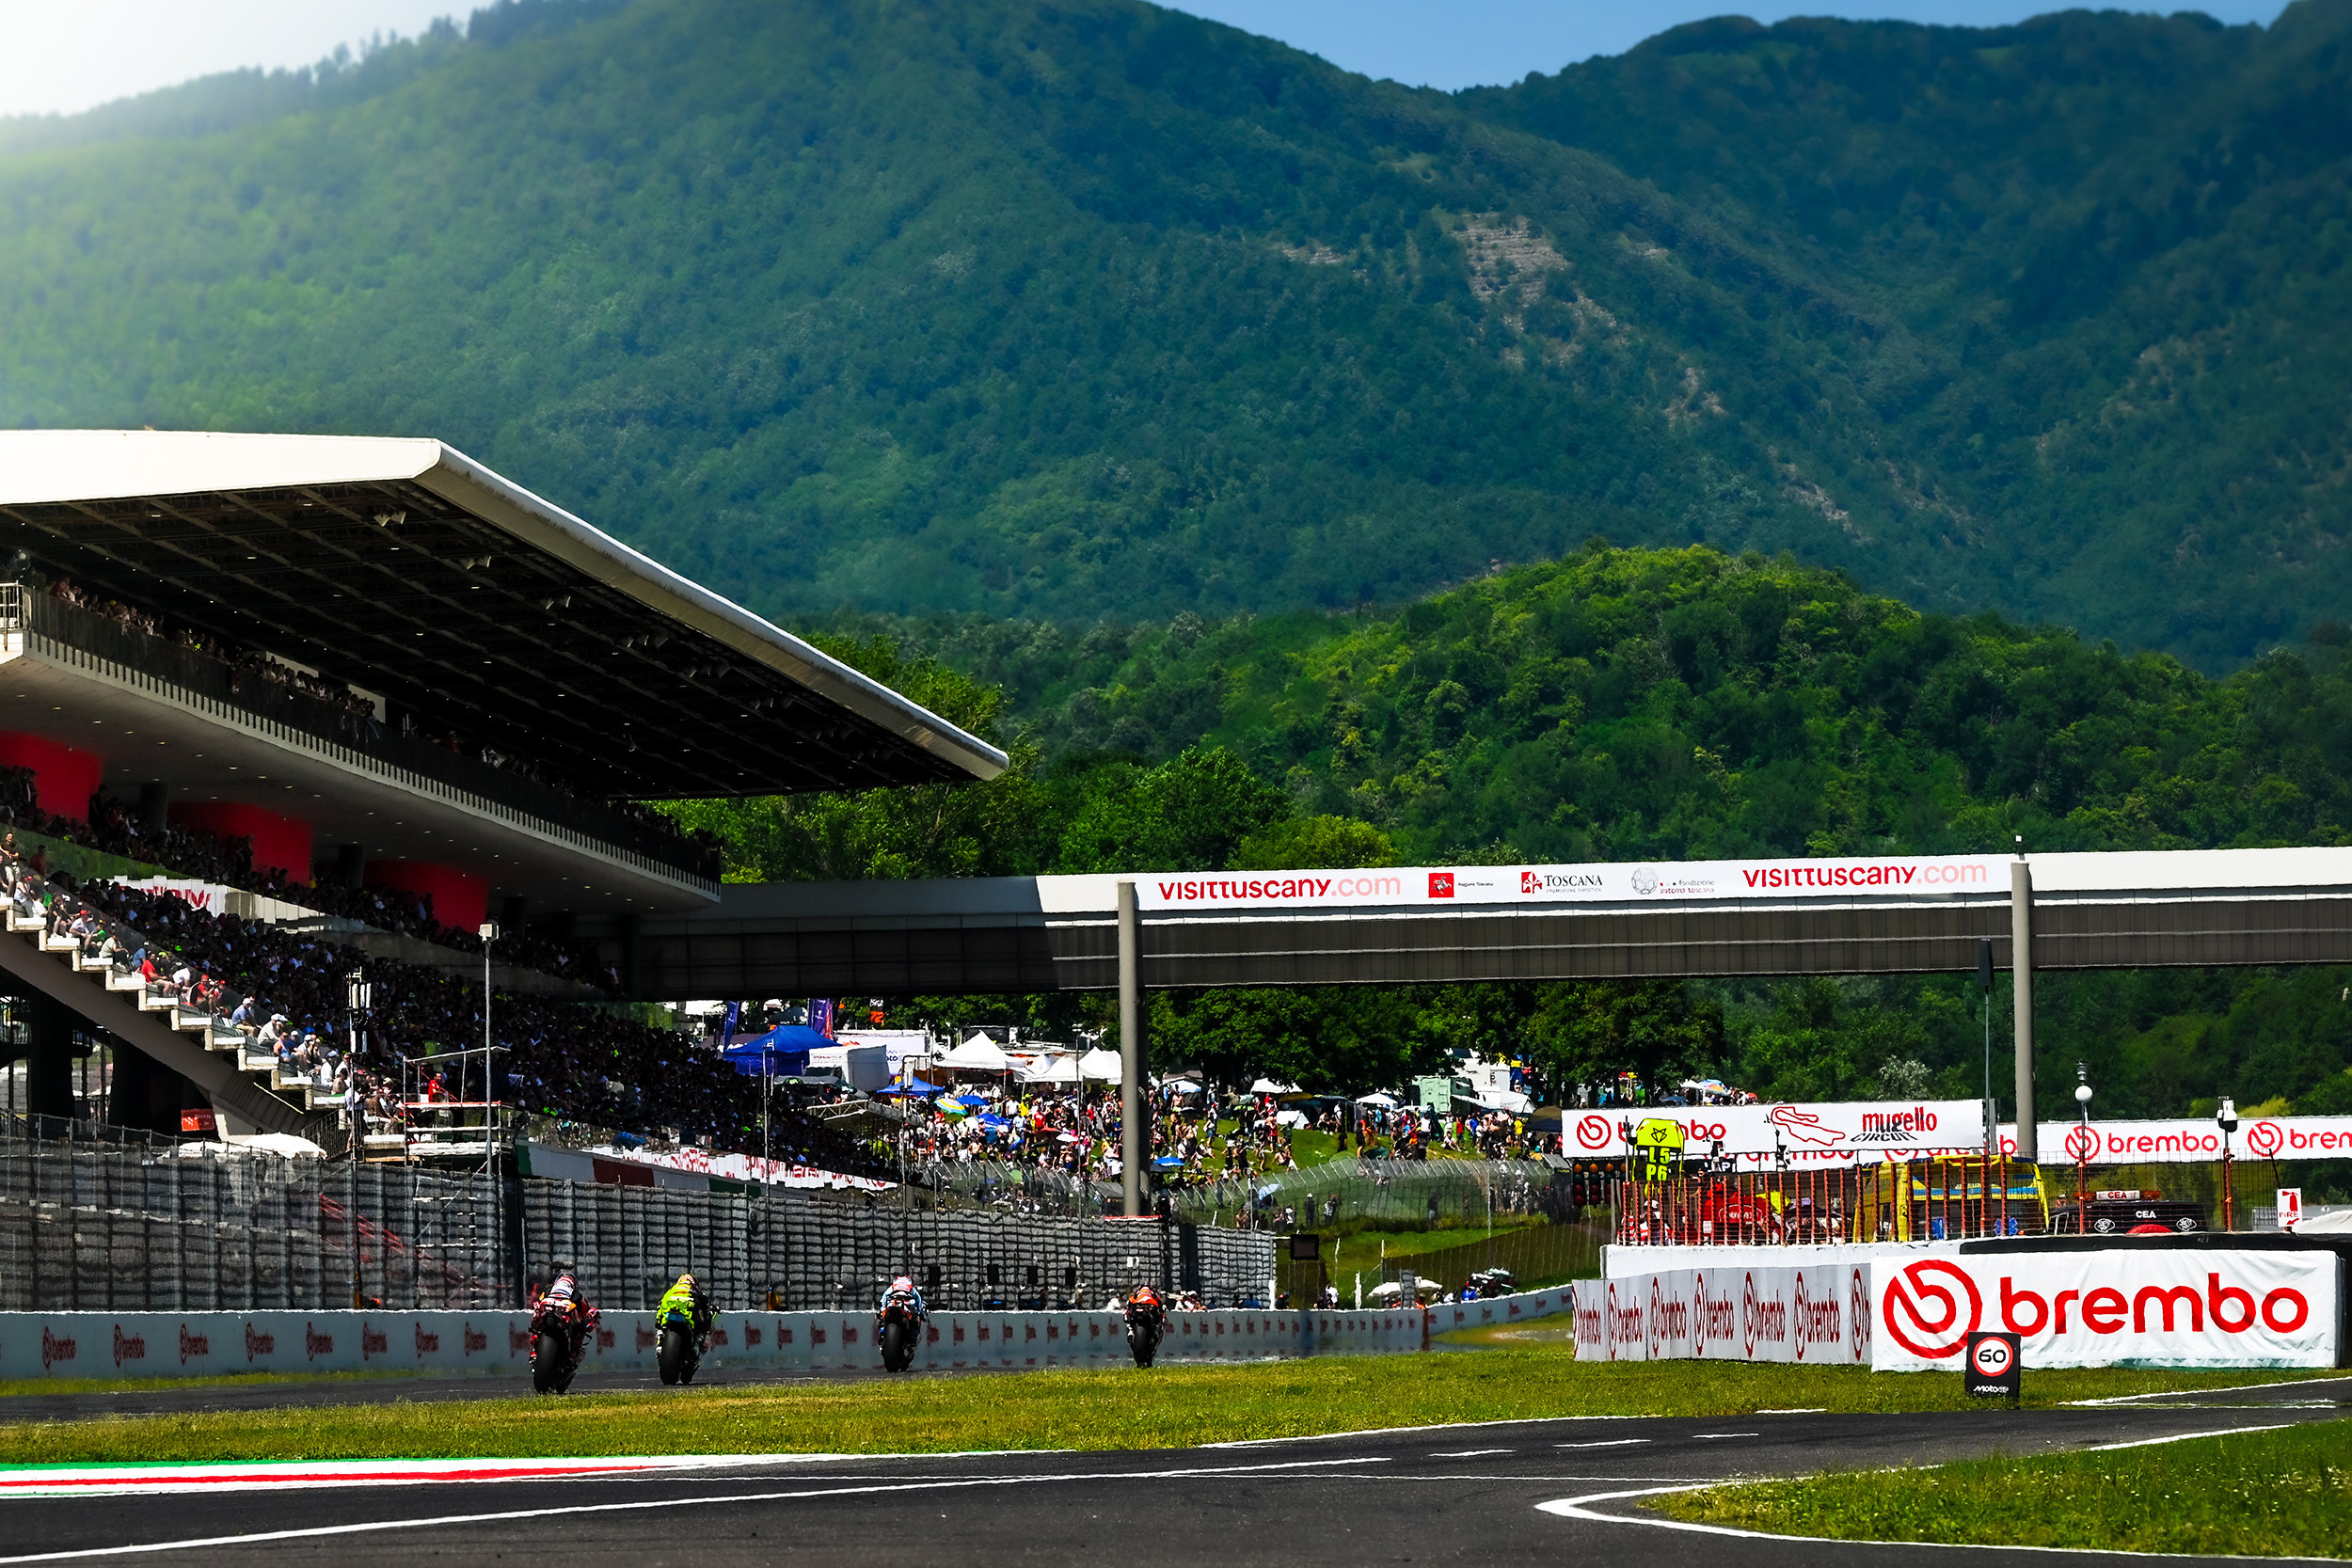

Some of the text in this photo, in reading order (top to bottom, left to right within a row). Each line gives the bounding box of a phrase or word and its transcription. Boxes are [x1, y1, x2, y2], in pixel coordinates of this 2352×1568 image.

[1544, 874, 1603, 887] TOSCANA
[1862, 1106, 1938, 1132] mugello
[1850, 1132, 1919, 1142] CIRCUIT
[2107, 1131, 2219, 1153] brembo
[2107, 1191, 2127, 1199] CEA
[2135, 1210, 2157, 1219] CEA
[2000, 1273, 2309, 1337] brembo
[1805, 1288, 1840, 1343] brembo
[1979, 1349, 2007, 1363] 60
